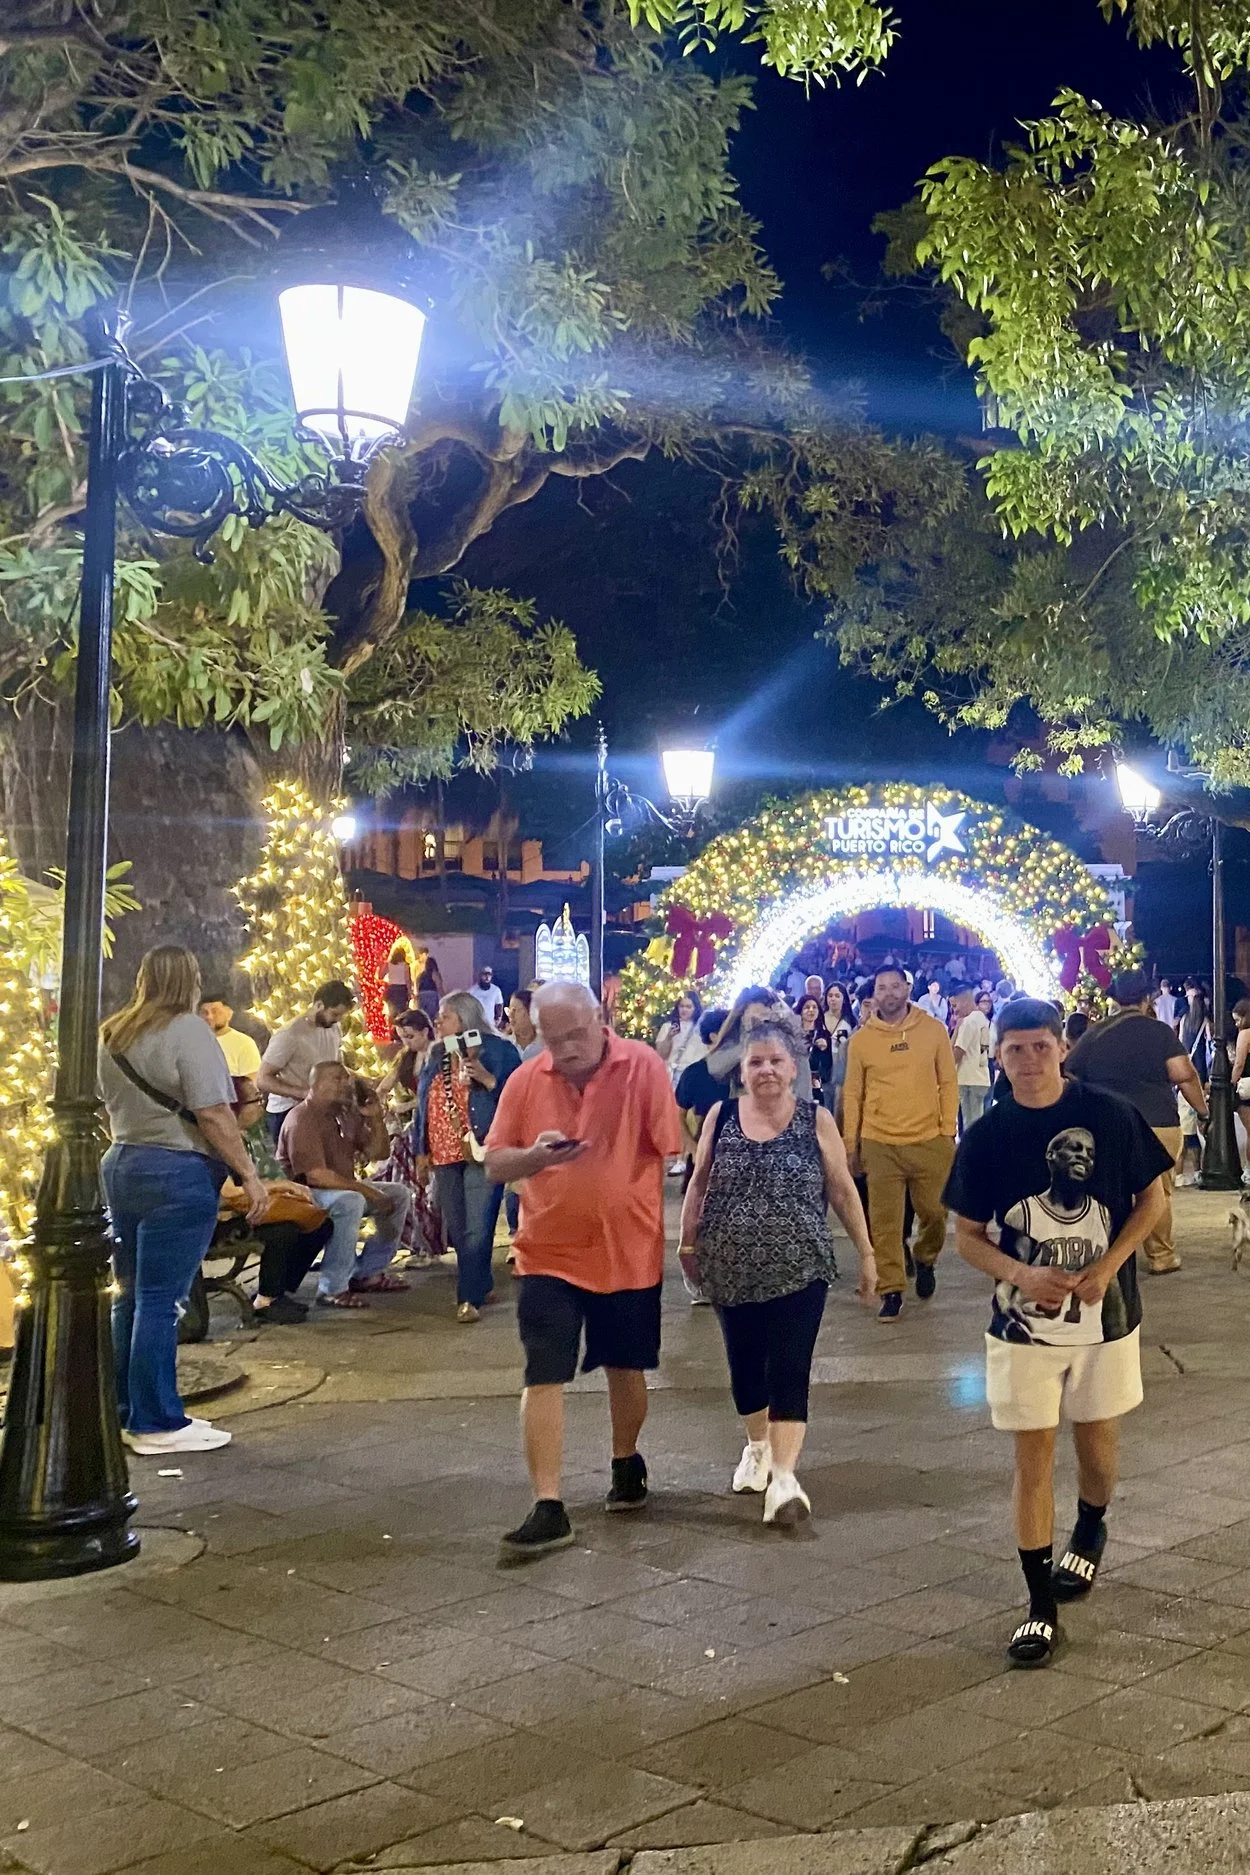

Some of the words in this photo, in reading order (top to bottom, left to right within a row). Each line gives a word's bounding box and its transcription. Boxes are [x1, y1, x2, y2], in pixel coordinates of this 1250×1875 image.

[909, 808, 925, 819] DE
[824, 817, 926, 840] TURISMO
[832, 839, 886, 853] PUERTO
[889, 840, 926, 853] RICO
[1060, 1551, 1096, 1581] NIKE
[1011, 1621, 1053, 1642] NIKE
